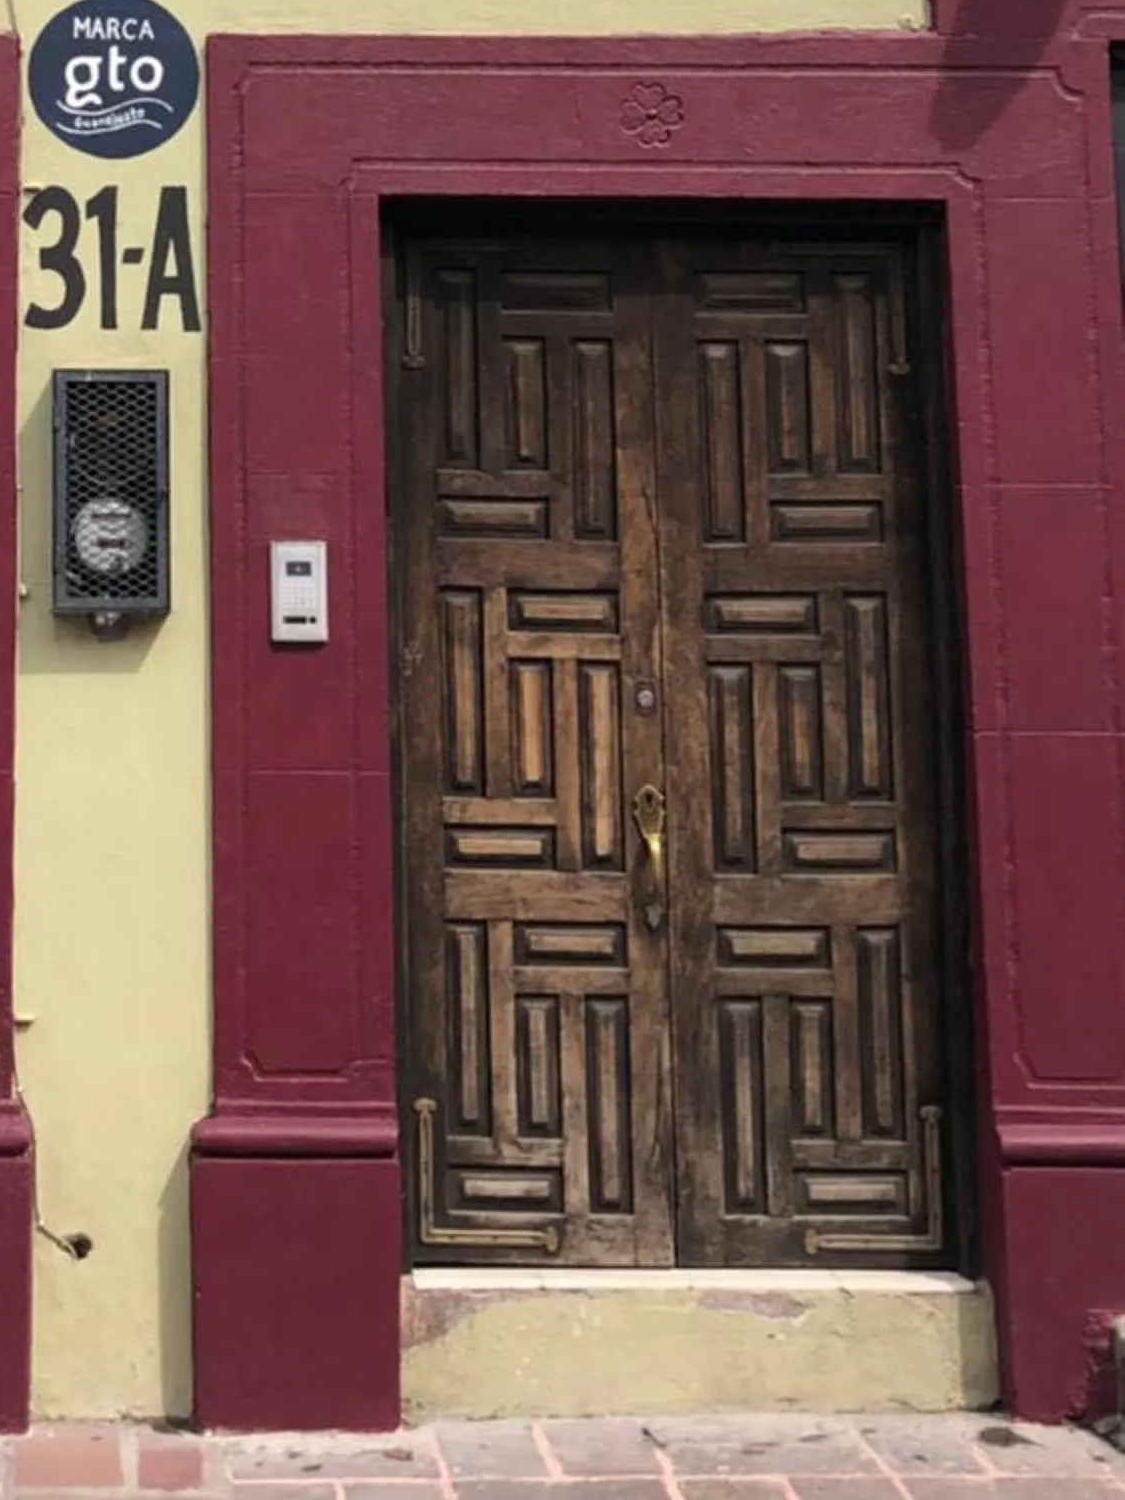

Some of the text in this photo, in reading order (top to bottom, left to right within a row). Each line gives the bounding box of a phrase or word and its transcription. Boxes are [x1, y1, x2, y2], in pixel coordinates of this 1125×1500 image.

[72, 16, 156, 41] MARCA
[64, 45, 165, 108] gto
[22, 184, 202, 333] 31-A
